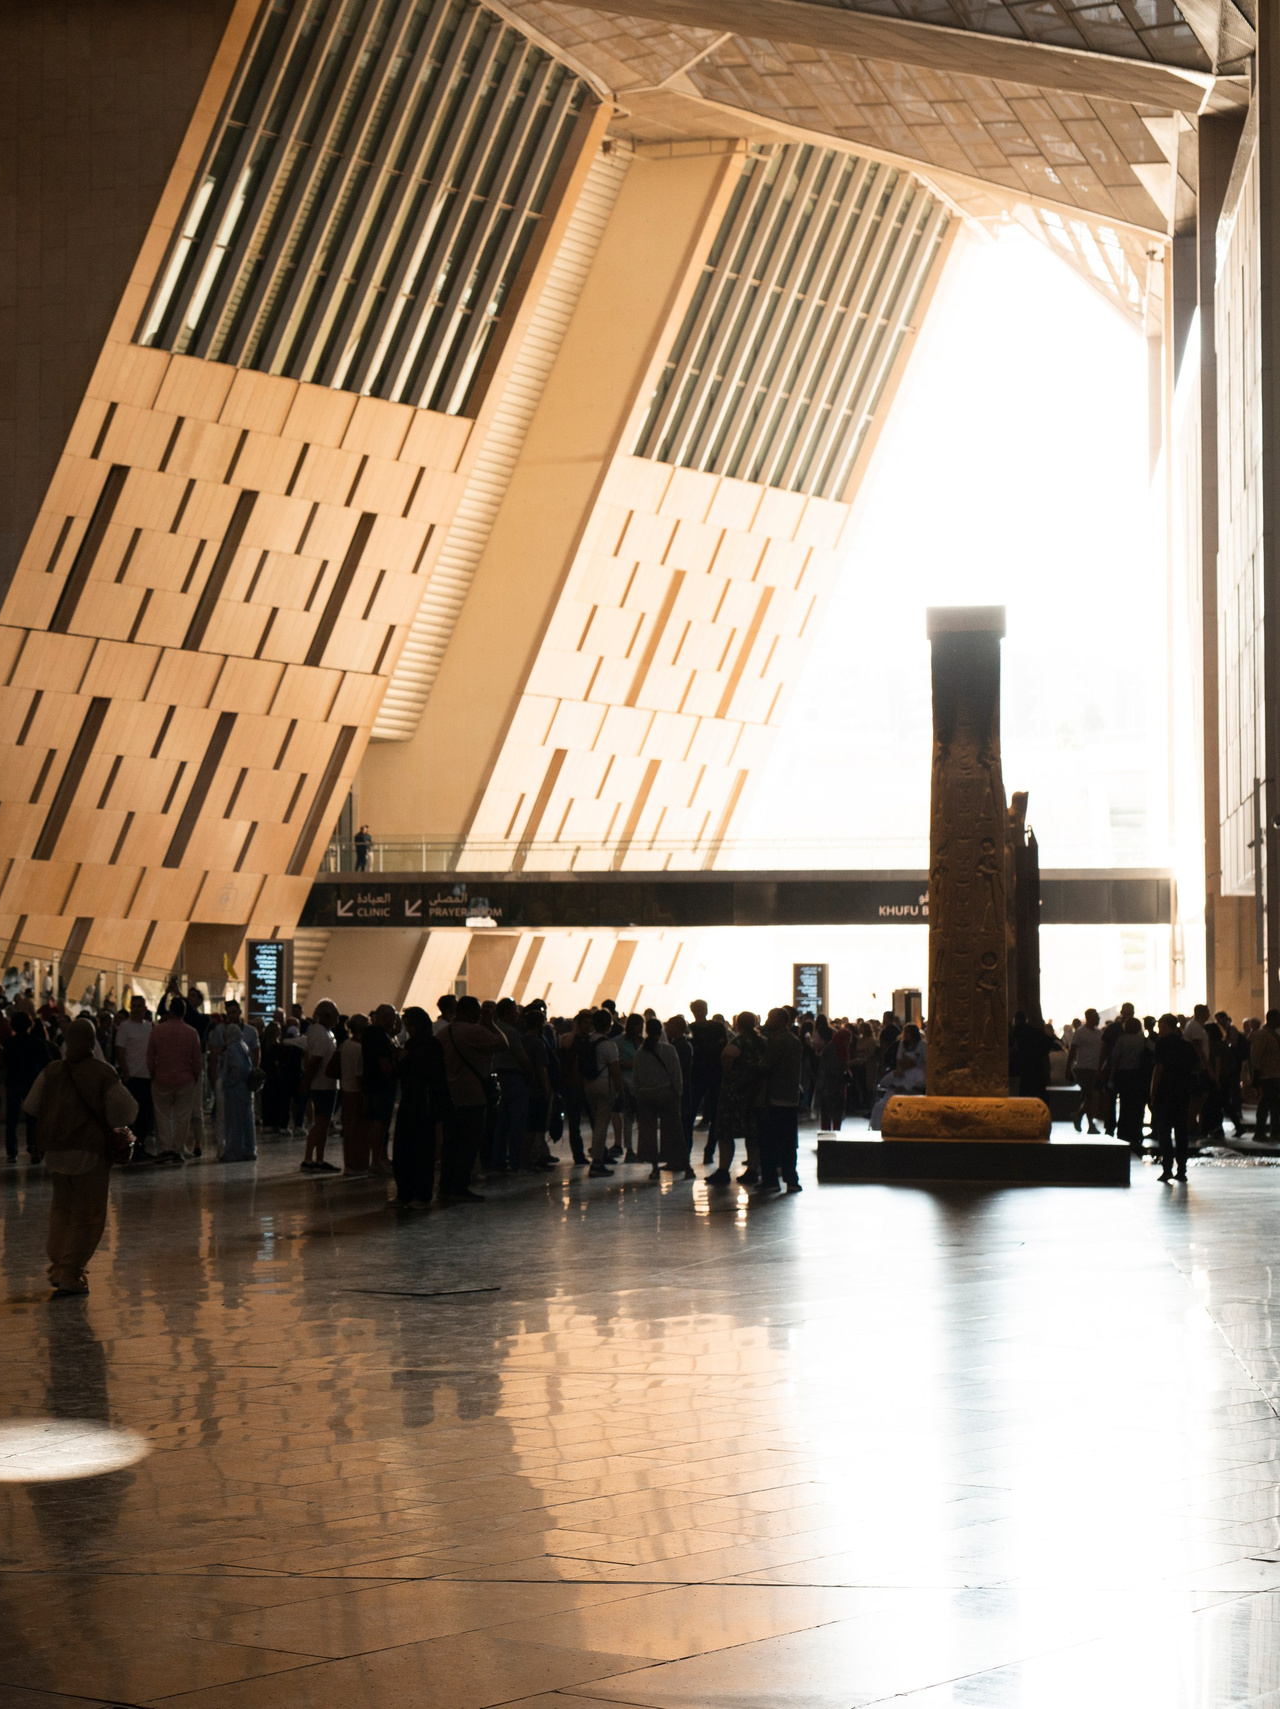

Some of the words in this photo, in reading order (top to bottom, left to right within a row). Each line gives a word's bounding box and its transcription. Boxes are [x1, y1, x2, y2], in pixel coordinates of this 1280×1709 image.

[356, 907, 391, 917] CLINIC
[428, 907, 468, 917] PRAYER
[470, 907, 503, 917] ROOM
[878, 905, 919, 916] KHUFU
